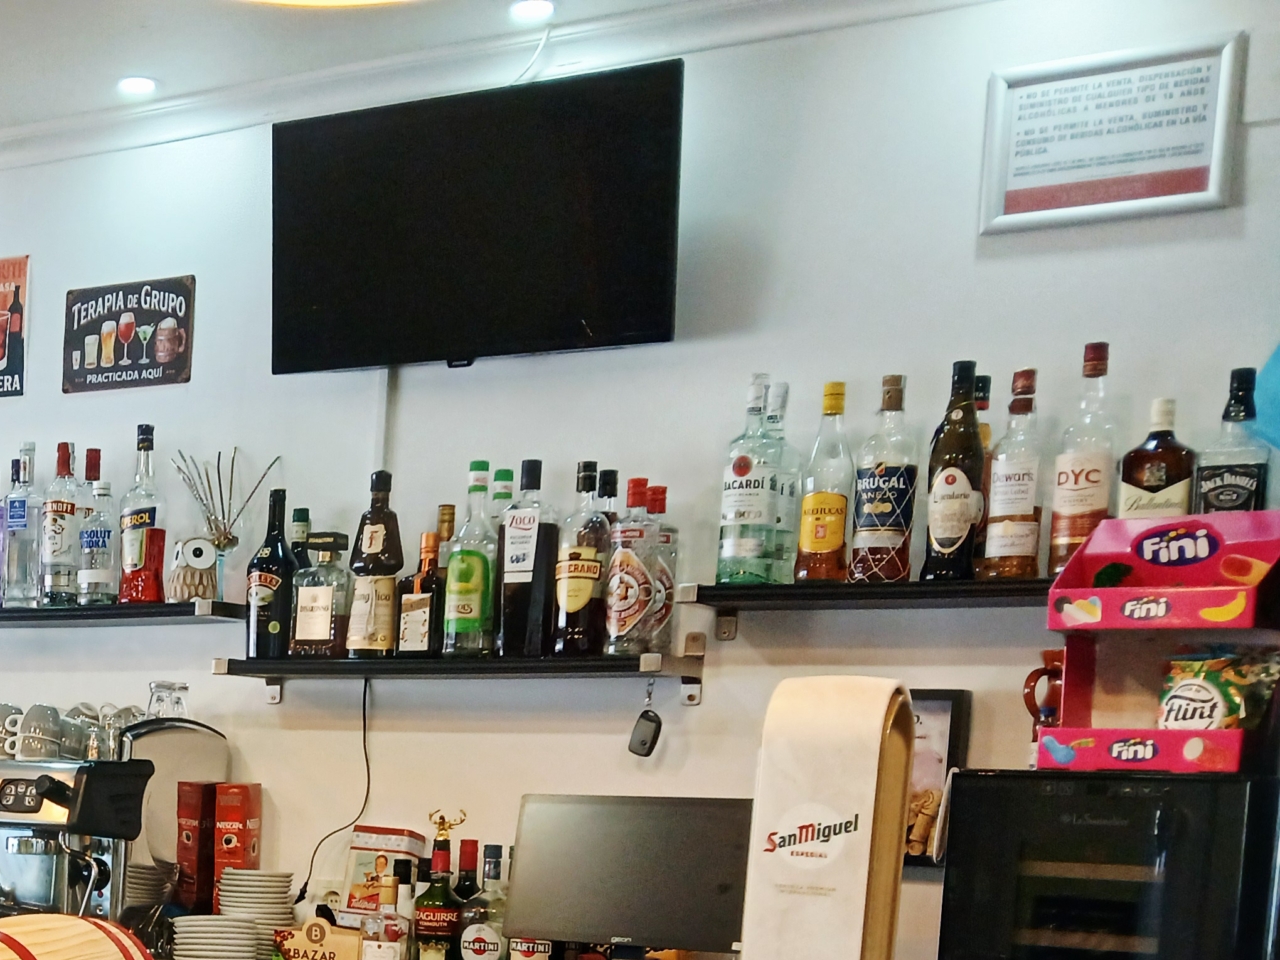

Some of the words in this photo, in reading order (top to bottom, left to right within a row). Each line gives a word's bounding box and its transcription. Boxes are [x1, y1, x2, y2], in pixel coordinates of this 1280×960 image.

[1137, 84, 1156, 93] TIPO
[1159, 82, 1169, 90] DE
[1174, 76, 1210, 88] BEBIDAS
[1166, 119, 1177, 127] EN
[1180, 116, 1190, 125] LA
[72, 291, 124, 330] TERAPIA
[127, 295, 138, 308] DE
[141, 285, 186, 317] GRUPO
[86, 370, 139, 384] PRACTICADA
[141, 367, 163, 380] AQUÍ
[857, 477, 905, 491] BRUGAL
[1057, 468, 1101, 486] DYC
[1201, 478, 1222, 492] JACK
[509, 515, 536, 528] ZOCO
[1142, 528, 1210, 563] Fini
[1124, 597, 1168, 619] Fini
[1111, 739, 1156, 760] Fini
[415, 910, 458, 921] ZAGUIRRE
[463, 941, 498, 951] MARTINI
[511, 941, 549, 953] MARTINI
